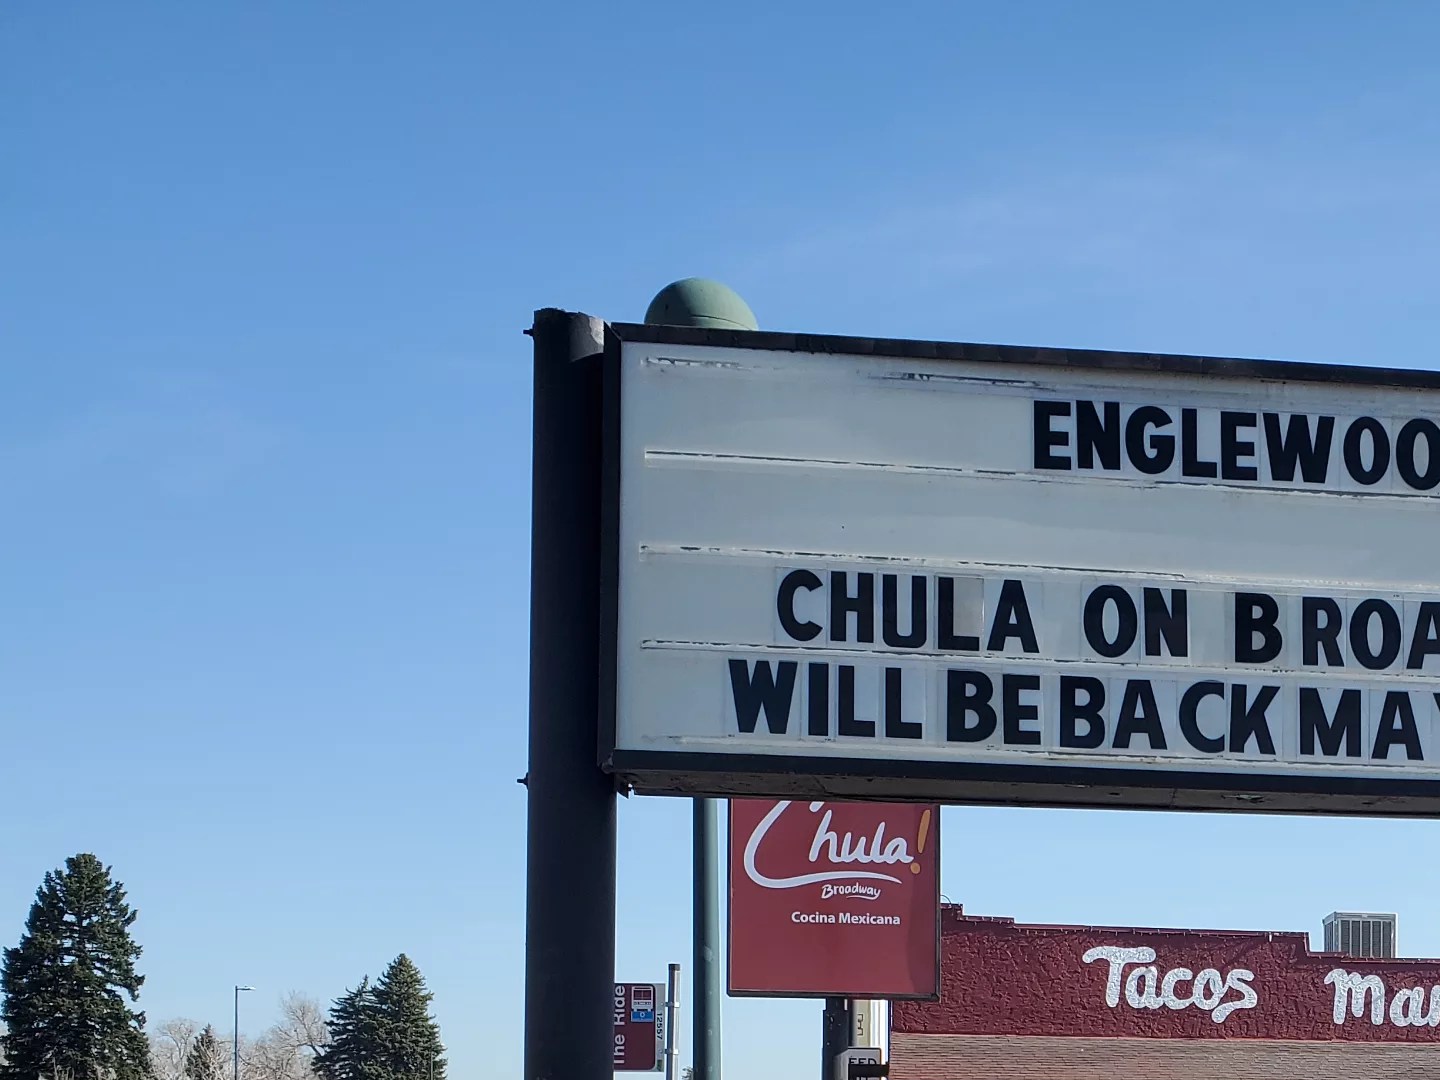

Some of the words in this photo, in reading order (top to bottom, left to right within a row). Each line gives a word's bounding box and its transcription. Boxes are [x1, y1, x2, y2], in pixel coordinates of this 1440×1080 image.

[777, 569, 1040, 653] CHULA
[1083, 584, 1188, 658] ON
[728, 659, 923, 740] WILL
[743, 801, 931, 889] Chula!
[791, 911, 835, 924] Cocina
[838, 912, 901, 925] Mexicana
[821, 882, 881, 900] Broadway
[1082, 946, 1258, 1023] Tacos
